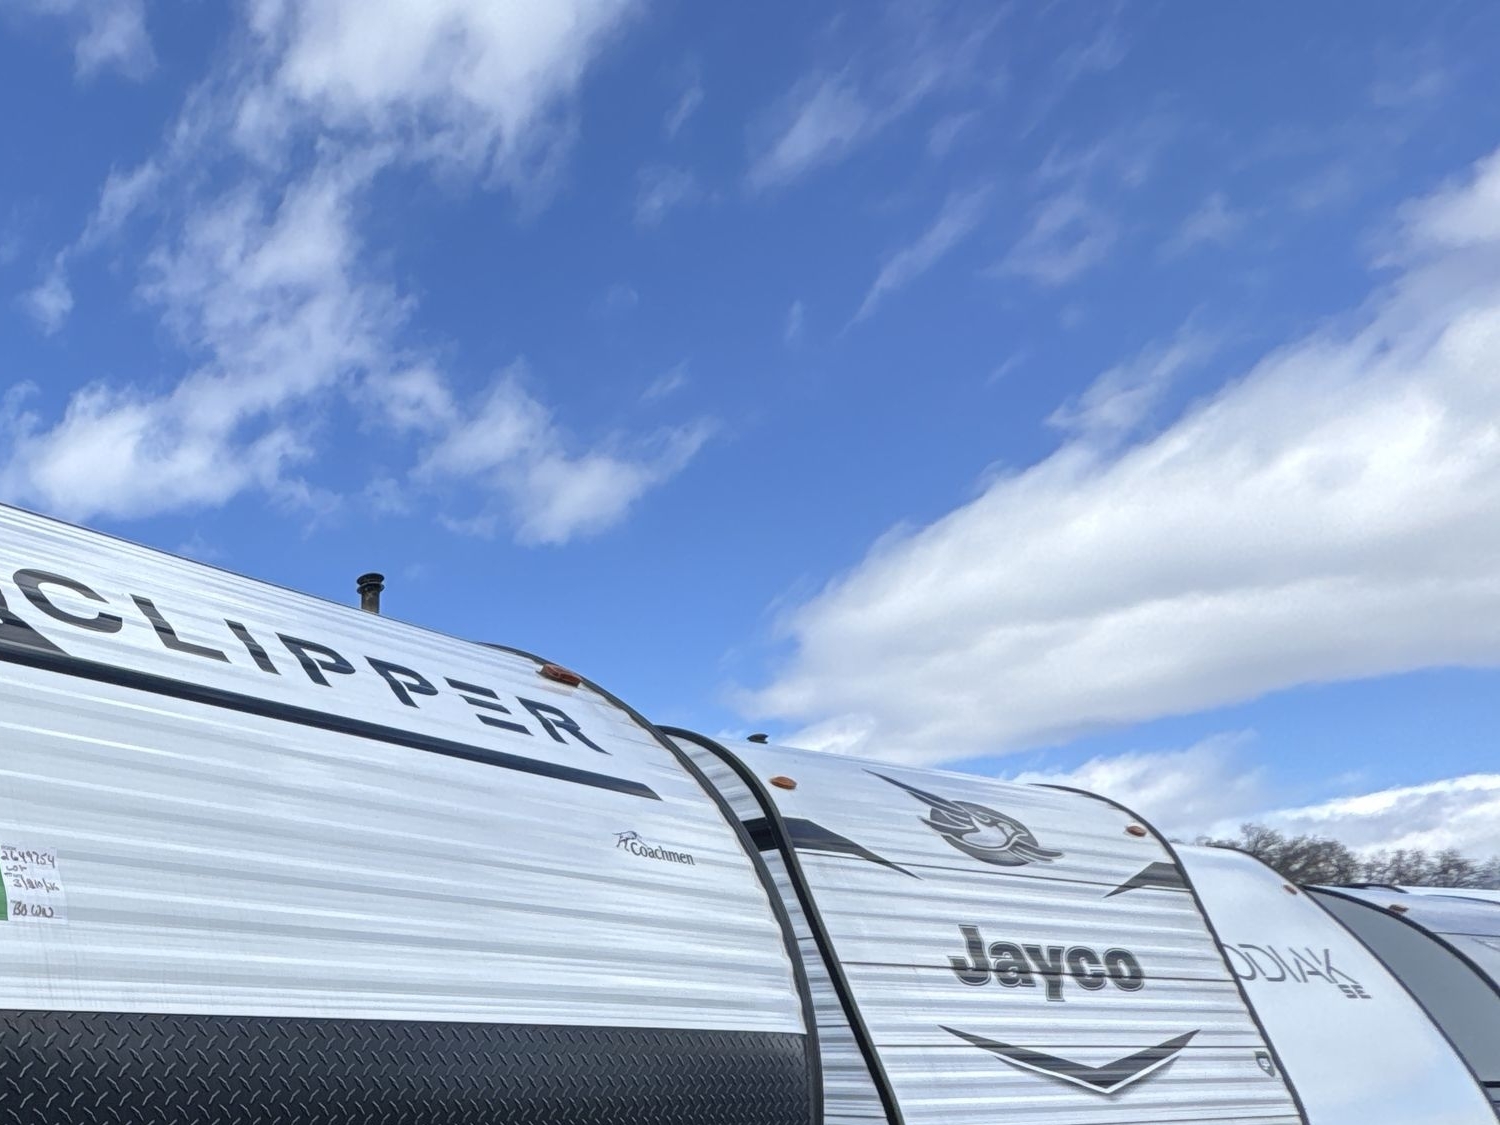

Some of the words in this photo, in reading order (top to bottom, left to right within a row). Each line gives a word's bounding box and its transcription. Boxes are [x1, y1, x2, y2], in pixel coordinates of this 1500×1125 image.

[12, 568, 612, 756] CLIPPER
[630, 841, 696, 866] Coachmen
[947, 924, 1145, 1002] Jayco
[1221, 943, 1360, 984] ODIAK
[1338, 984, 1373, 999] SE
